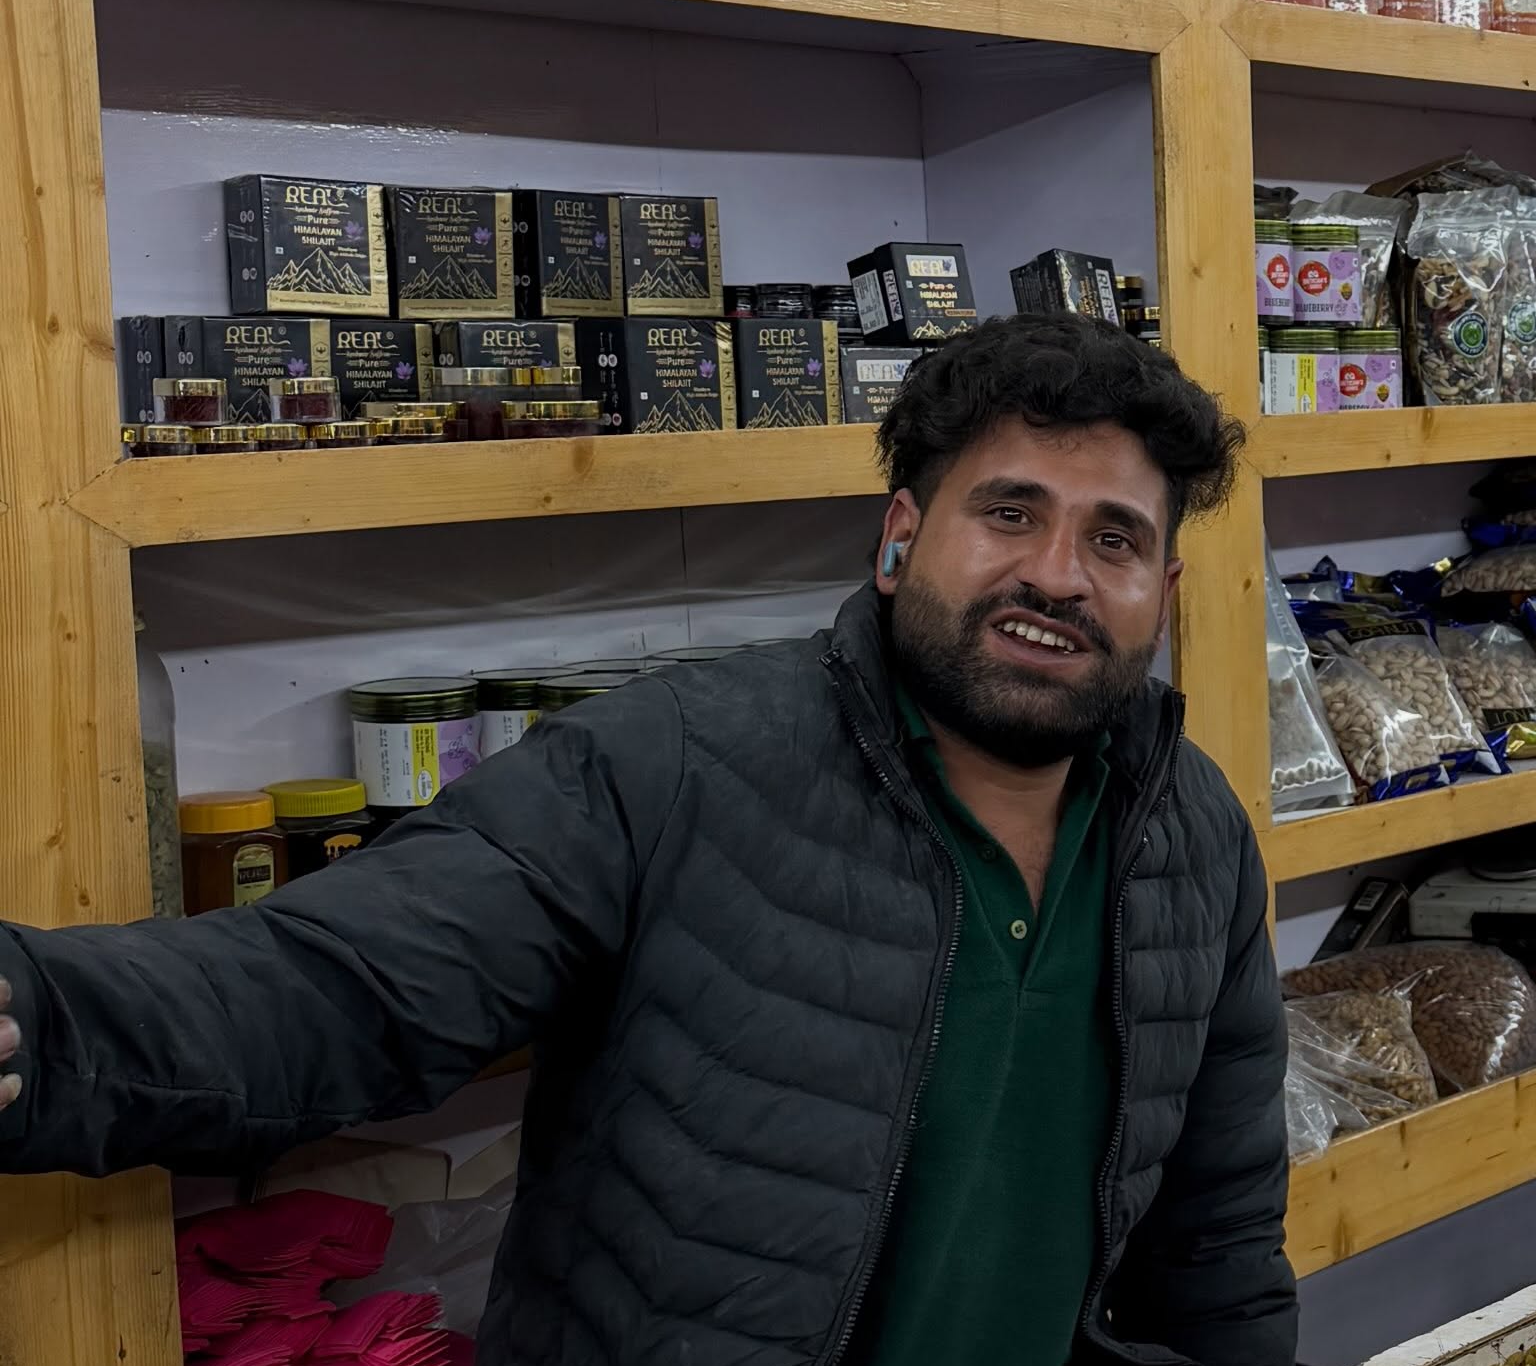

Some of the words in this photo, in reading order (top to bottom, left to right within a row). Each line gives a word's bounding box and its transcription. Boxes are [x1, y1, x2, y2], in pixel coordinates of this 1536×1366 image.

[285, 186, 349, 208] REAL
[418, 197, 478, 215] REAL
[640, 203, 691, 221] REAL
[307, 215, 329, 224] Pure
[293, 225, 343, 236] HIMALAYAN
[437, 224, 458, 233] Pure
[302, 236, 336, 246] SHILAJIT
[425, 235, 471, 244] HIMALAYAN
[432, 244, 465, 254] SHILAJIT
[225, 326, 291, 345] REAL
[337, 331, 398, 350] REAL
[482, 329, 542, 348] REAL
[248, 356, 271, 365] Pure
[358, 358, 380, 368] Pure
[503, 356, 523, 366] Pure
[666, 356, 686, 366] Pure
[234, 367, 284, 376] HIMALAYAN
[345, 370, 393, 379] HIMALAYAN
[655, 368, 698, 378] HIMALAYAN
[353, 380, 386, 389] SHILAJIT
[662, 378, 692, 388] SHILAJIT
